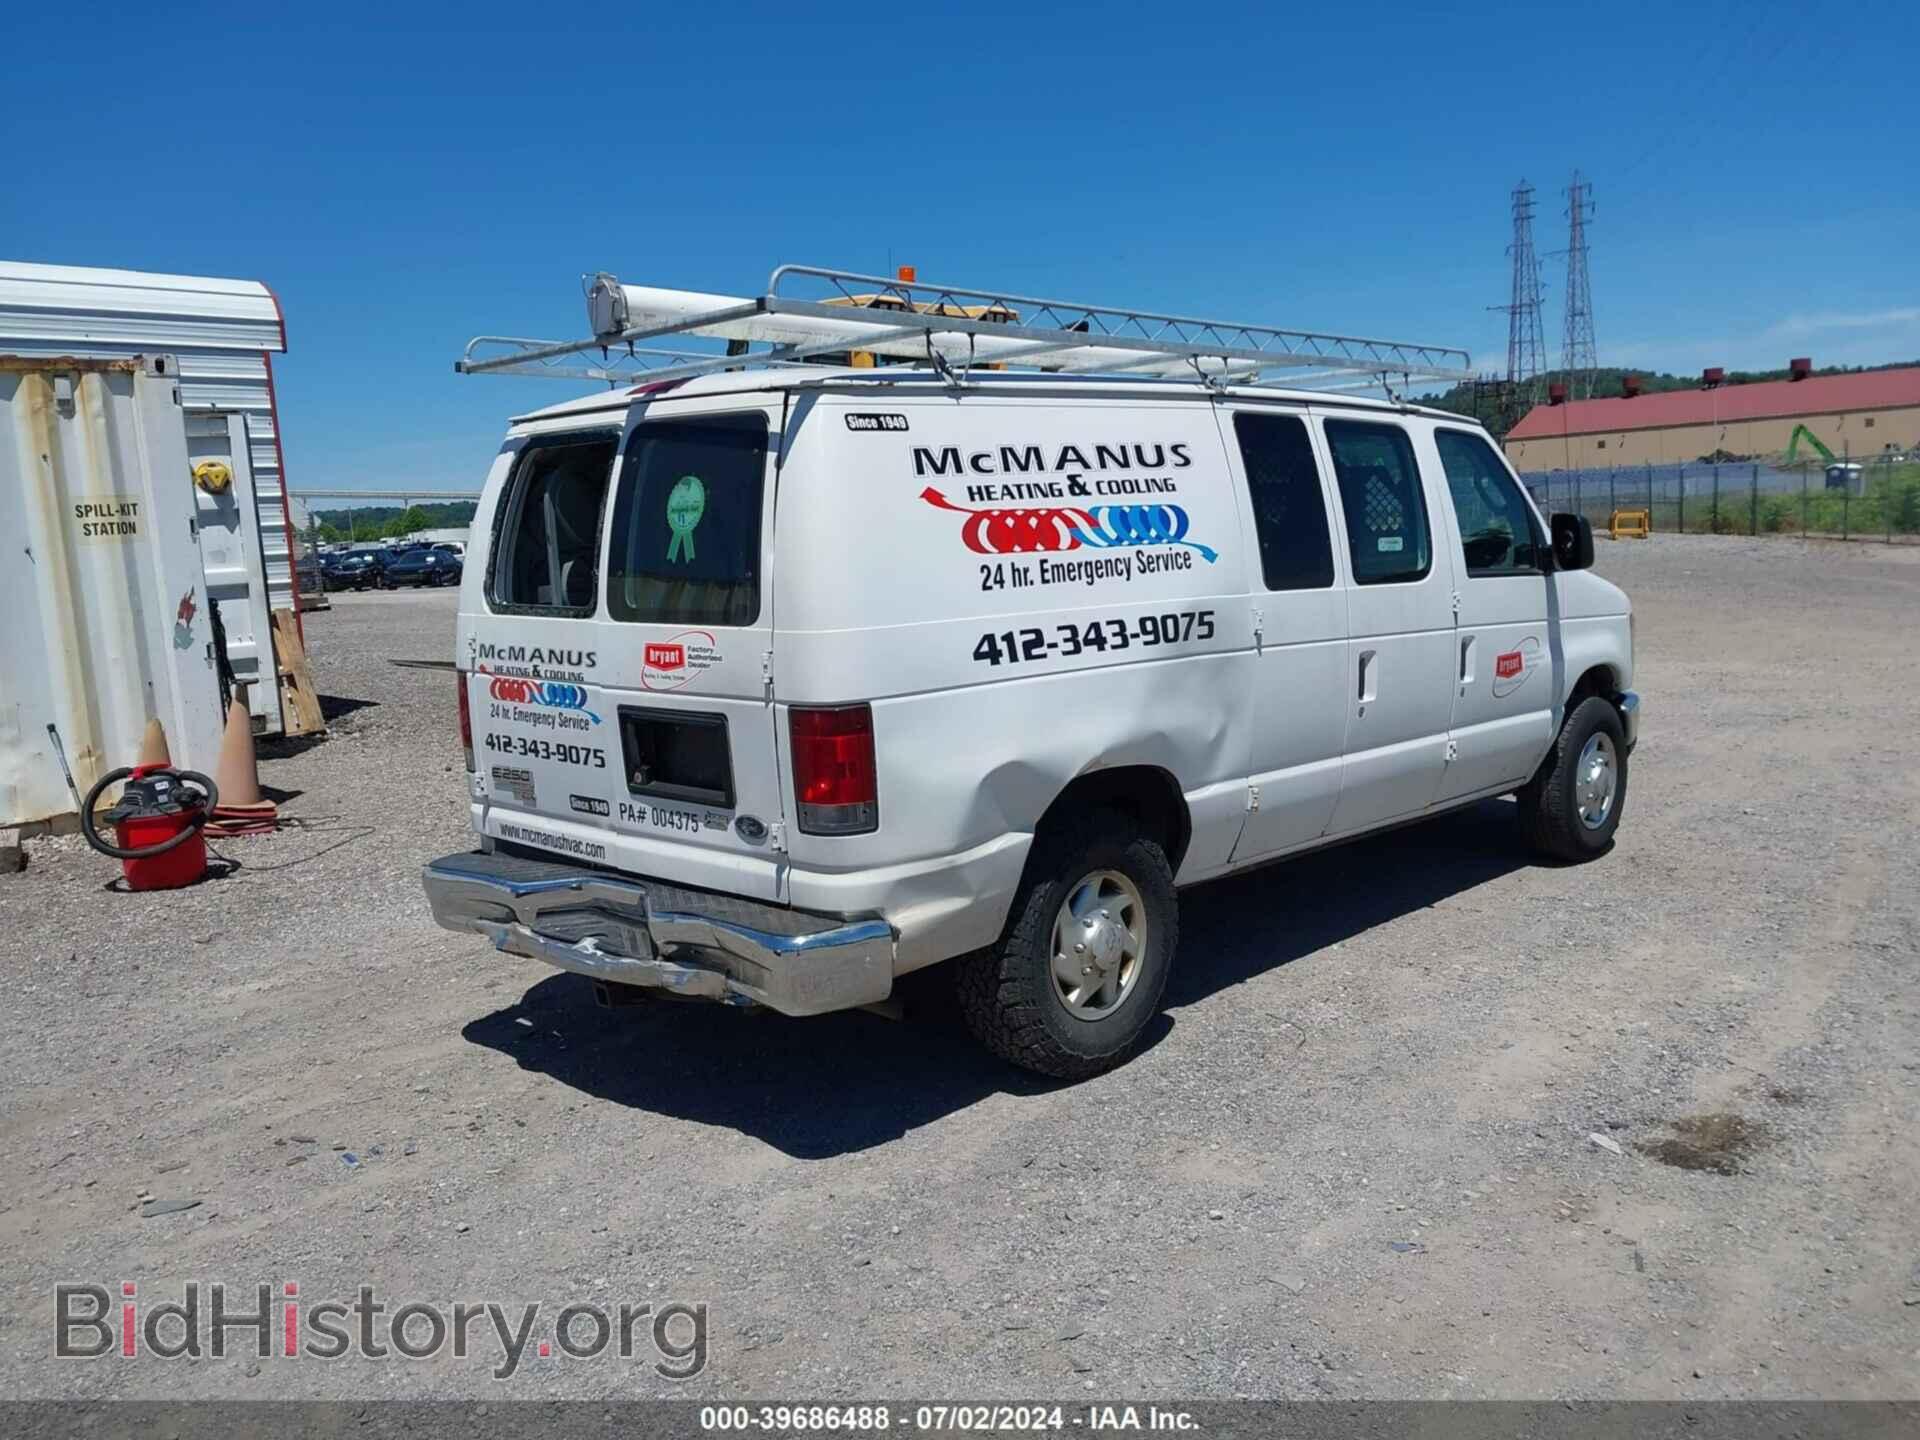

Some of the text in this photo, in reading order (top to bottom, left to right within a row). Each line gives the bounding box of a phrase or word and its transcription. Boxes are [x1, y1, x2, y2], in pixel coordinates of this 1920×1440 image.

[847, 415, 906, 429] Since 1949
[913, 443, 1192, 475] McMANUS
[967, 473, 1176, 502] HEATING & COOLING
[75, 503, 138, 518] SPILL-KIT
[82, 521, 136, 536] STATION
[980, 547, 1192, 591] 24 hr. Emergency Service
[972, 610, 1215, 666] 412-343-9075
[479, 643, 597, 668] McMANUS
[494, 664, 584, 681] HEATING & COOLING
[490, 703, 500, 718] 24
[513, 706, 556, 730] Emergency
[558, 712, 590, 731] Service
[485, 732, 606, 769] 412-343-9075
[619, 802, 647, 824] PA#
[651, 807, 699, 832] 004375
[500, 823, 606, 860] www.mcmanushvac.com
